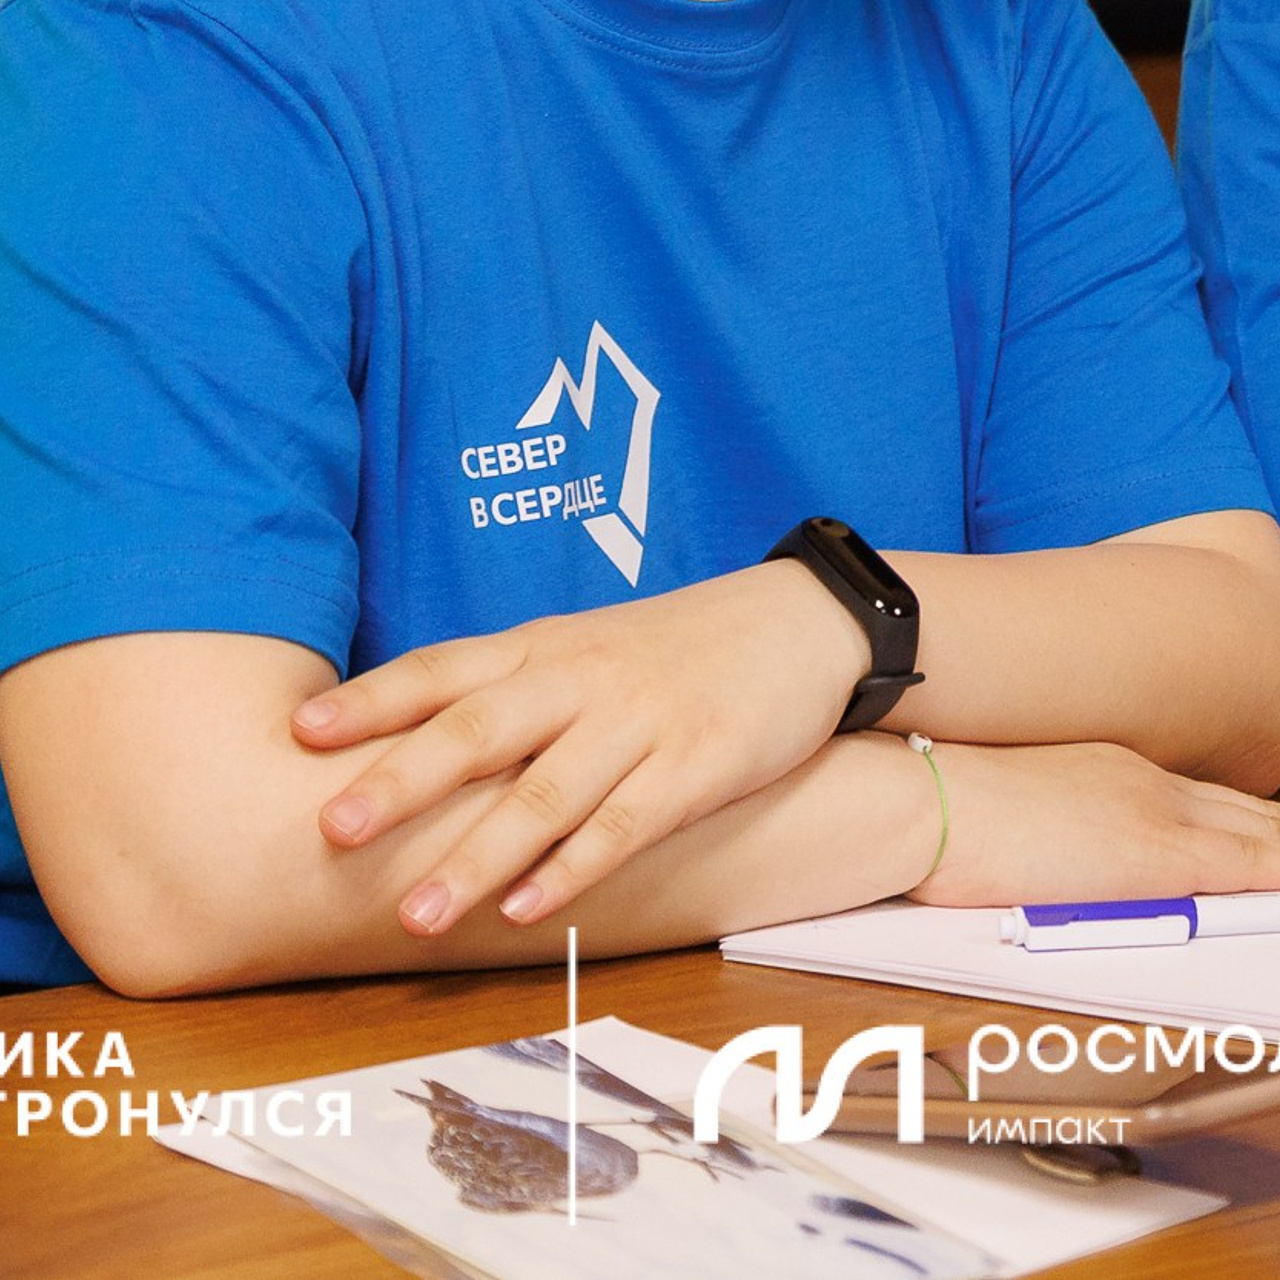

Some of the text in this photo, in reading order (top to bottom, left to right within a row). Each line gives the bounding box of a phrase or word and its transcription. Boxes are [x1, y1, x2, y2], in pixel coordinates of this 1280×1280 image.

[461, 433, 567, 480] СЕВЕР
[469, 473, 607, 529] В СЕРДЦЕ
